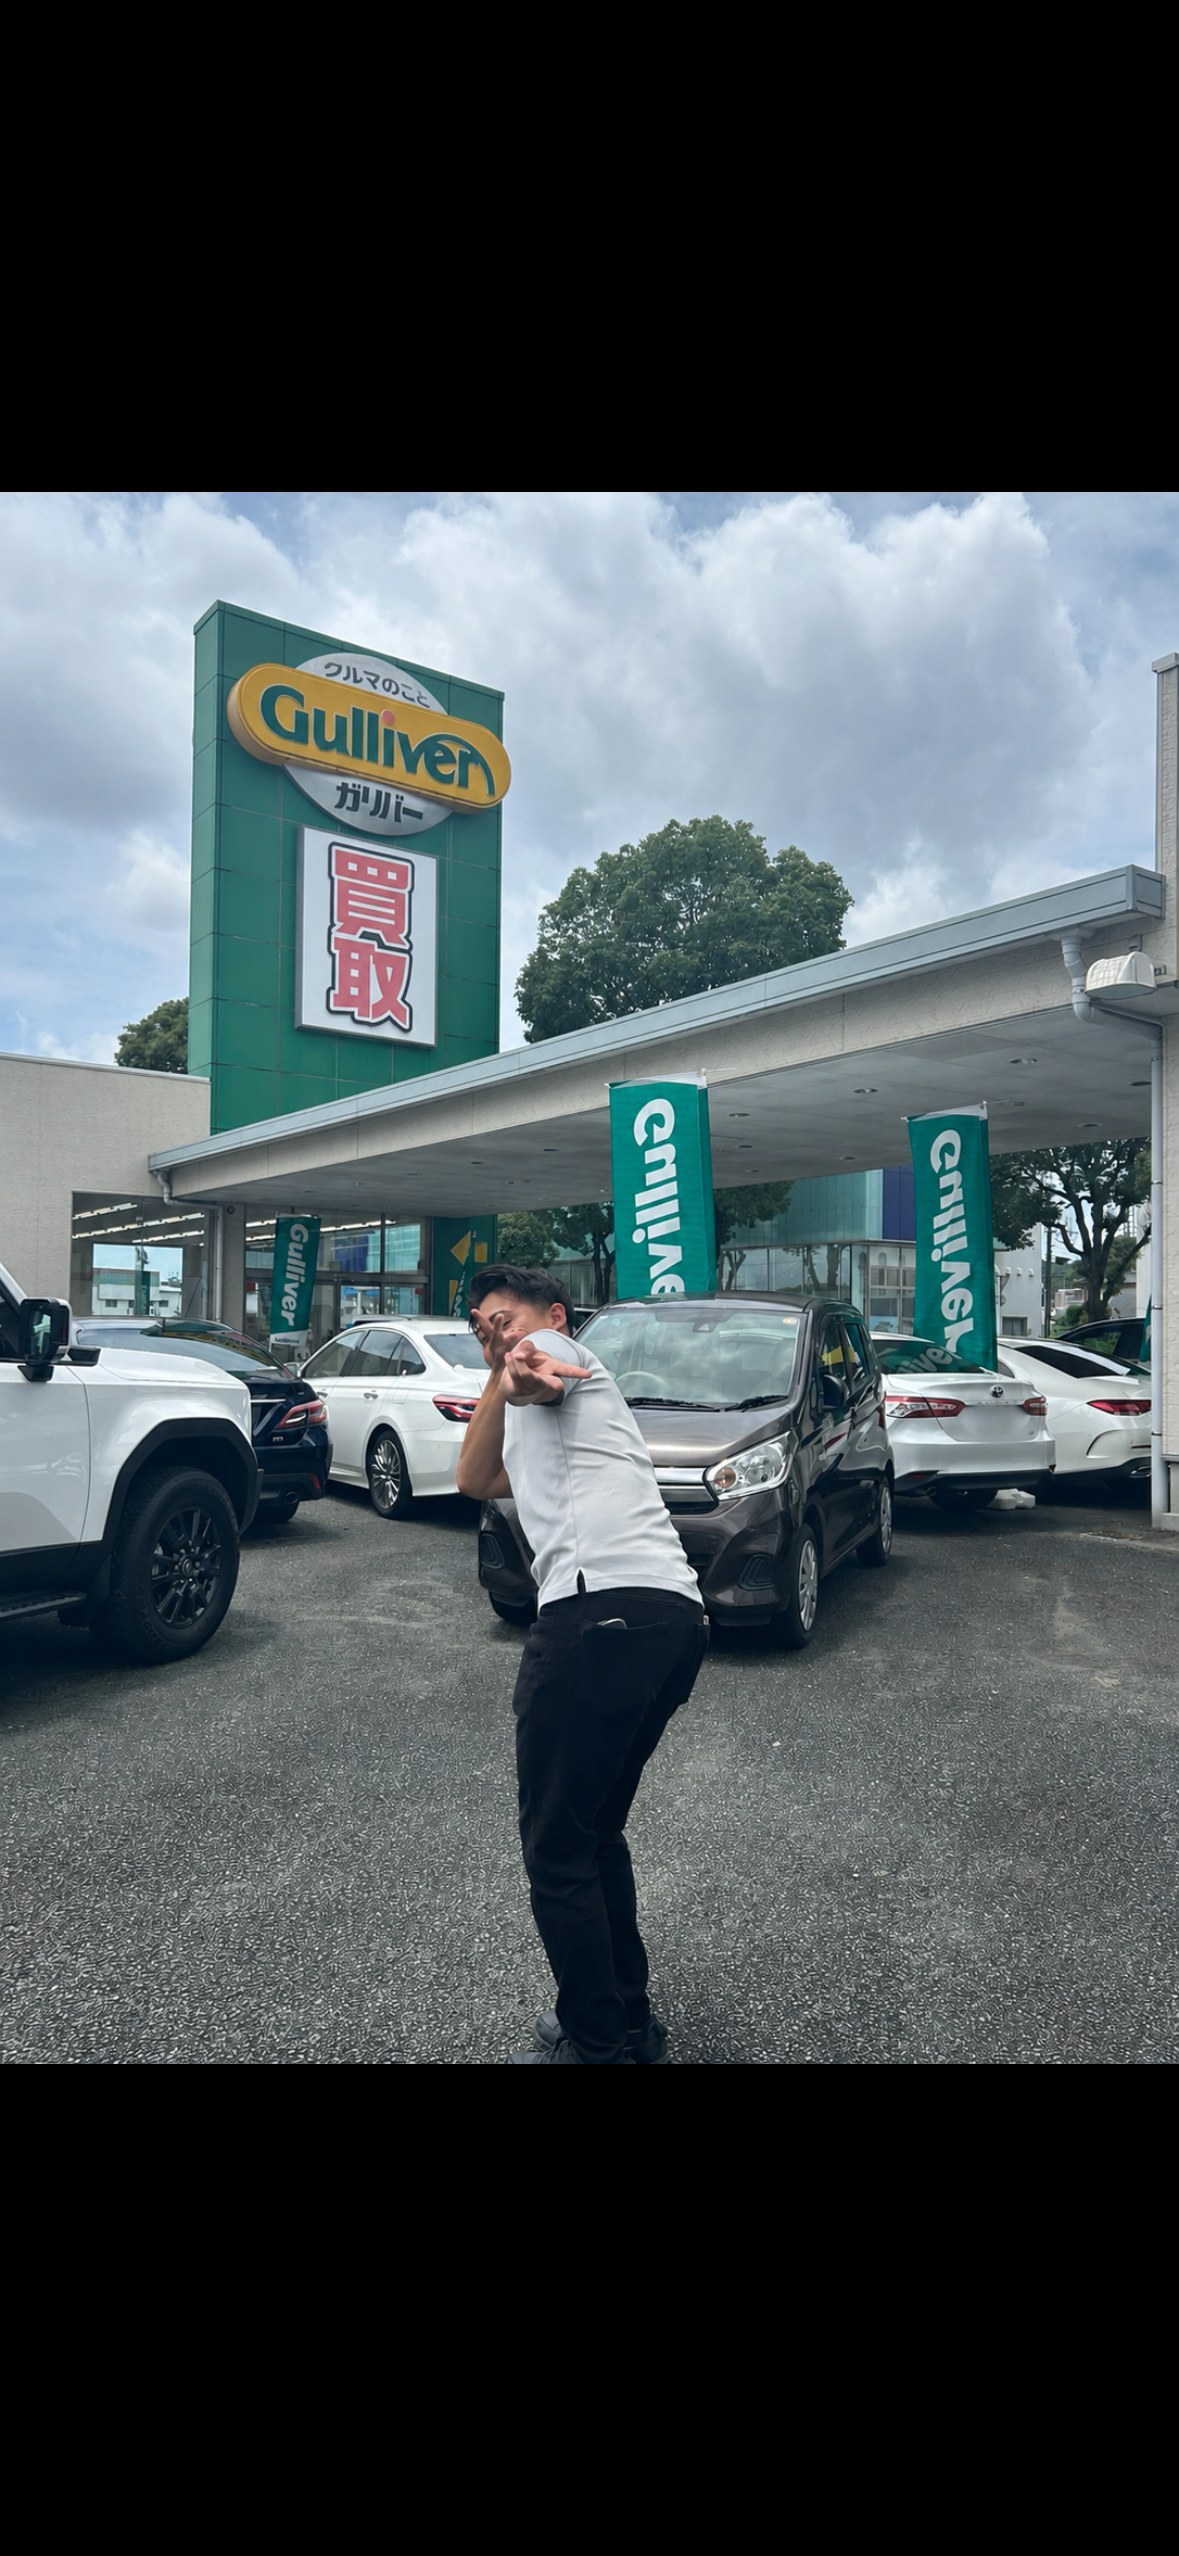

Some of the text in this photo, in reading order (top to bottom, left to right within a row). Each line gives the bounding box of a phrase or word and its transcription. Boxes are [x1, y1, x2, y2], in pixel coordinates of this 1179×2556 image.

[324, 661, 430, 709] クルマのこと
[260, 683, 496, 796] Gulliver
[334, 782, 423, 823] ガリバー
[330, 845, 412, 1030] 買取
[281, 1223, 309, 1327] Gulliver
